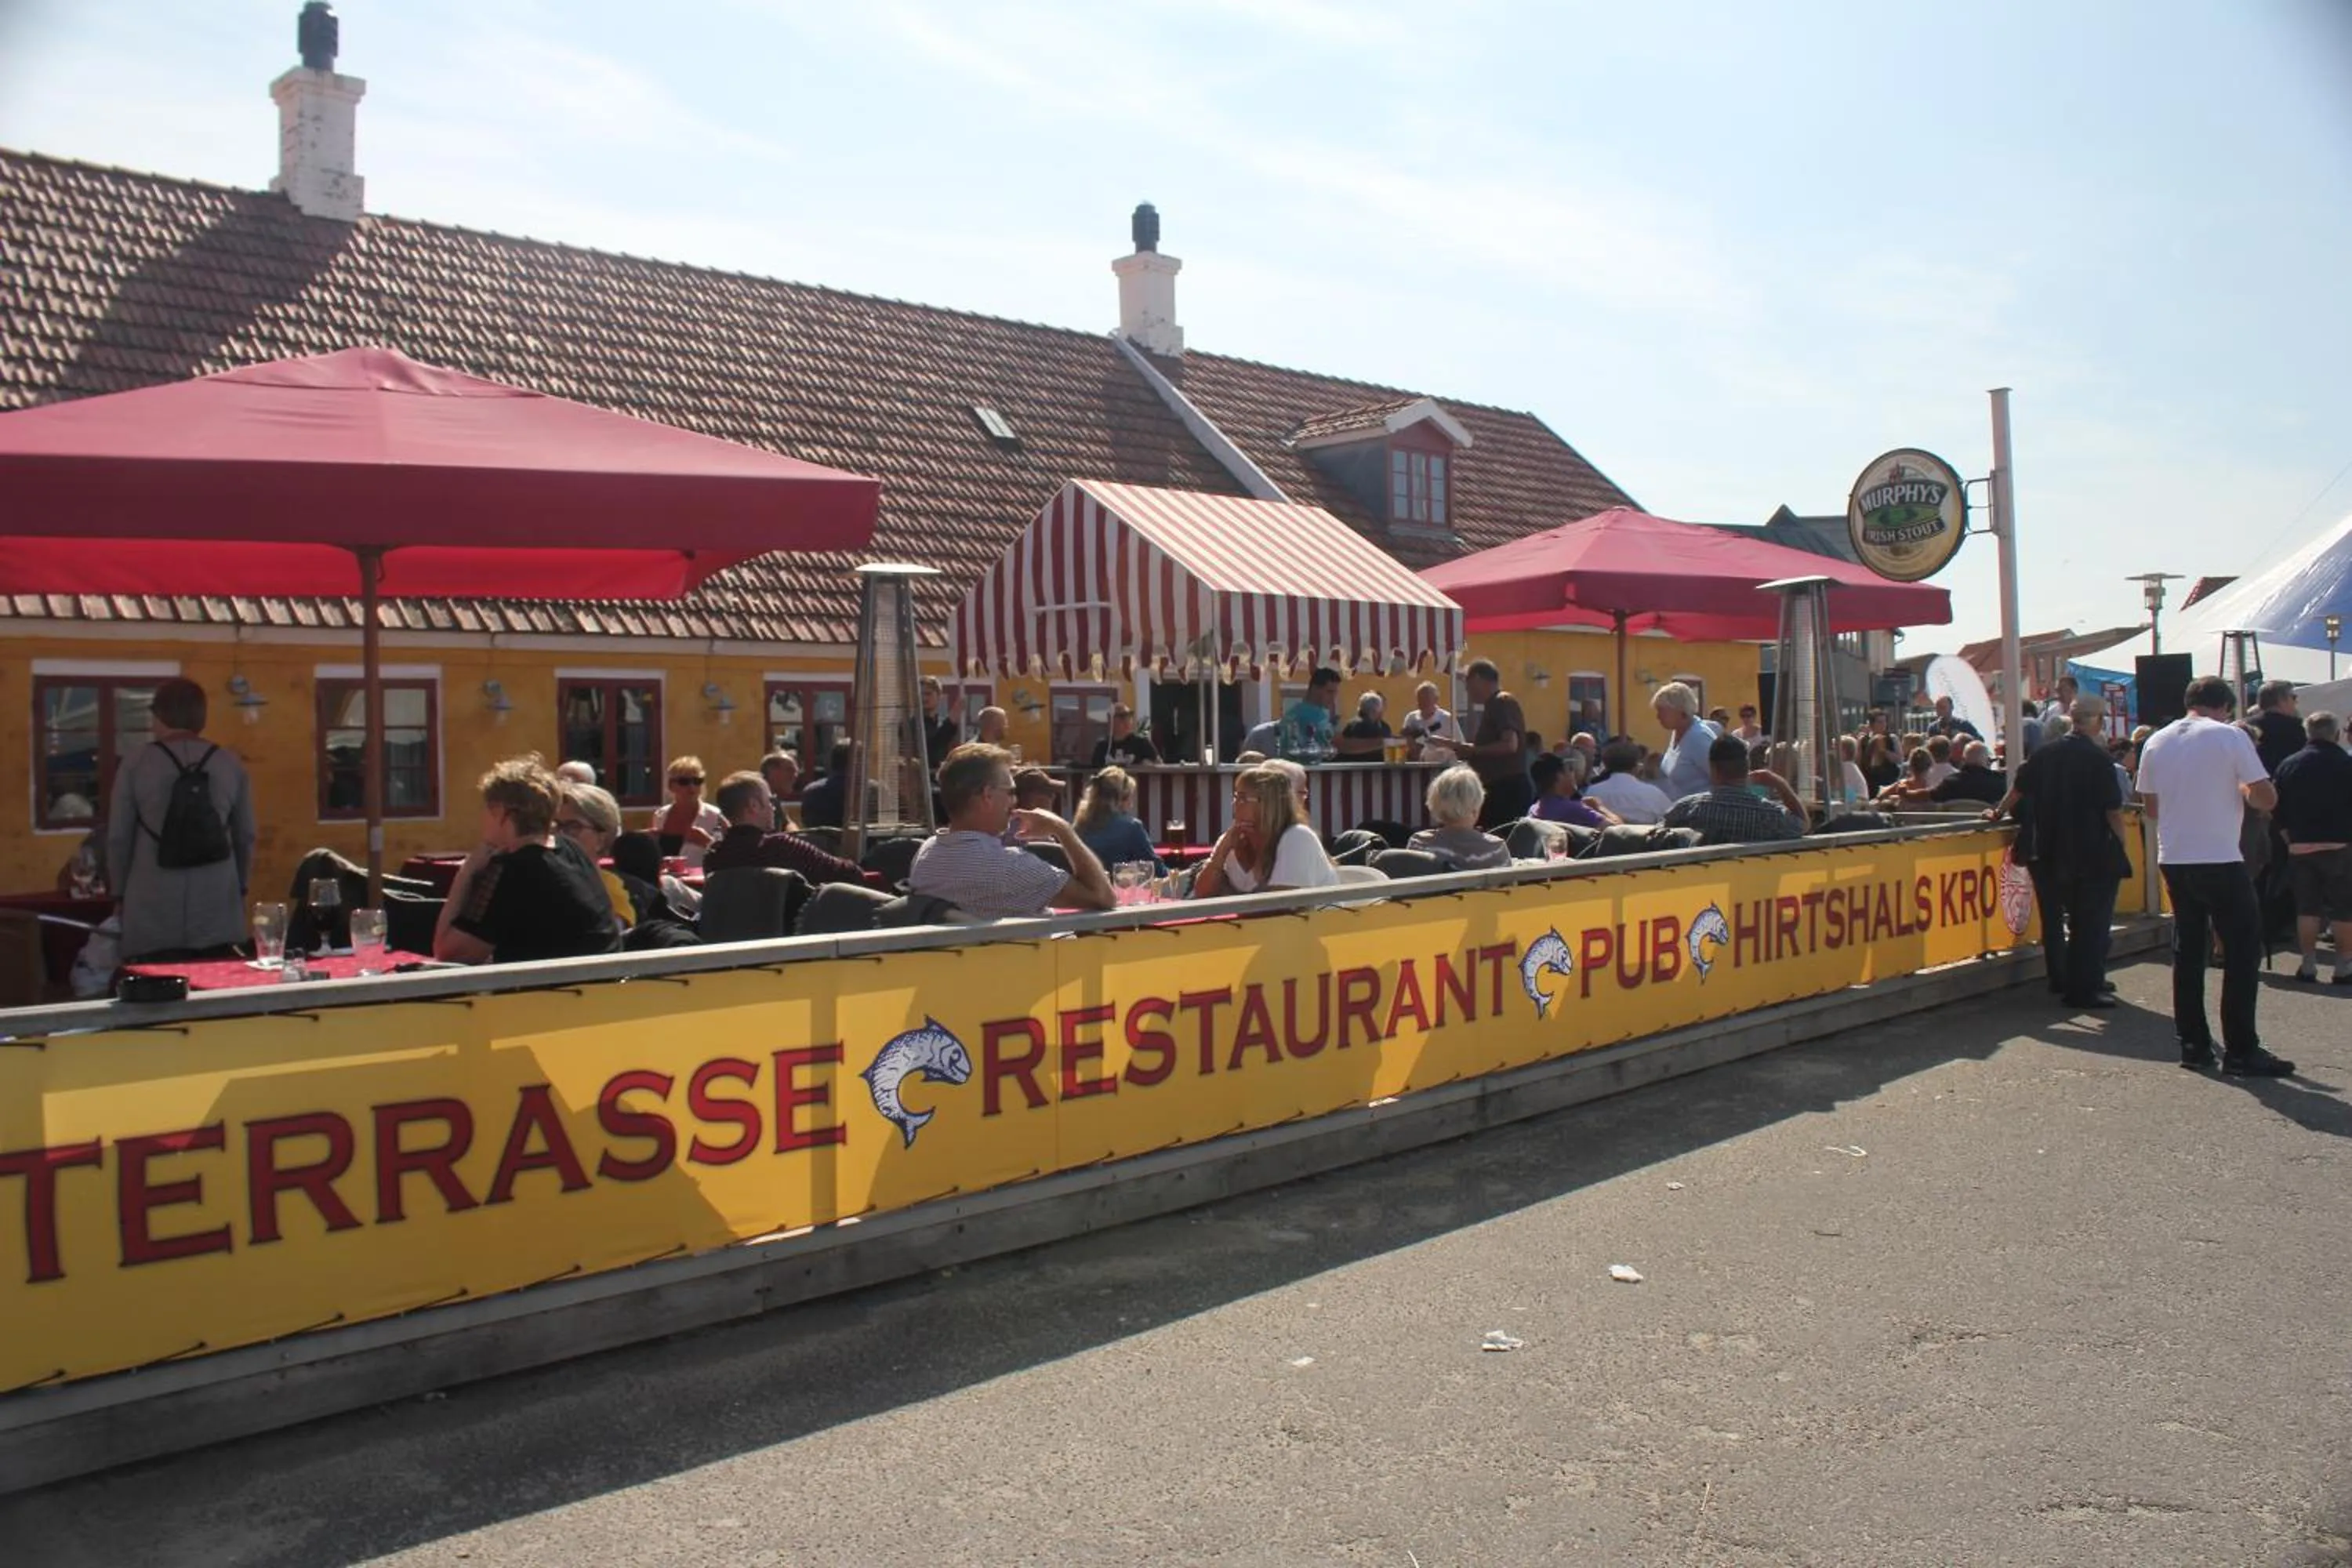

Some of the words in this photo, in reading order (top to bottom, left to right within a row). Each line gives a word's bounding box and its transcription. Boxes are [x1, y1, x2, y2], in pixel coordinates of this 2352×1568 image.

[1866, 528, 1896, 543] IRISH
[1898, 520, 1939, 539] STOUT
[0, 1040, 848, 1283] TERRASSE
[982, 942, 1515, 1116] RESTAURANT
[1579, 916, 1681, 997] PUB
[1733, 875, 1933, 967] HIRTSHALS
[1940, 865, 1997, 927] KRO
